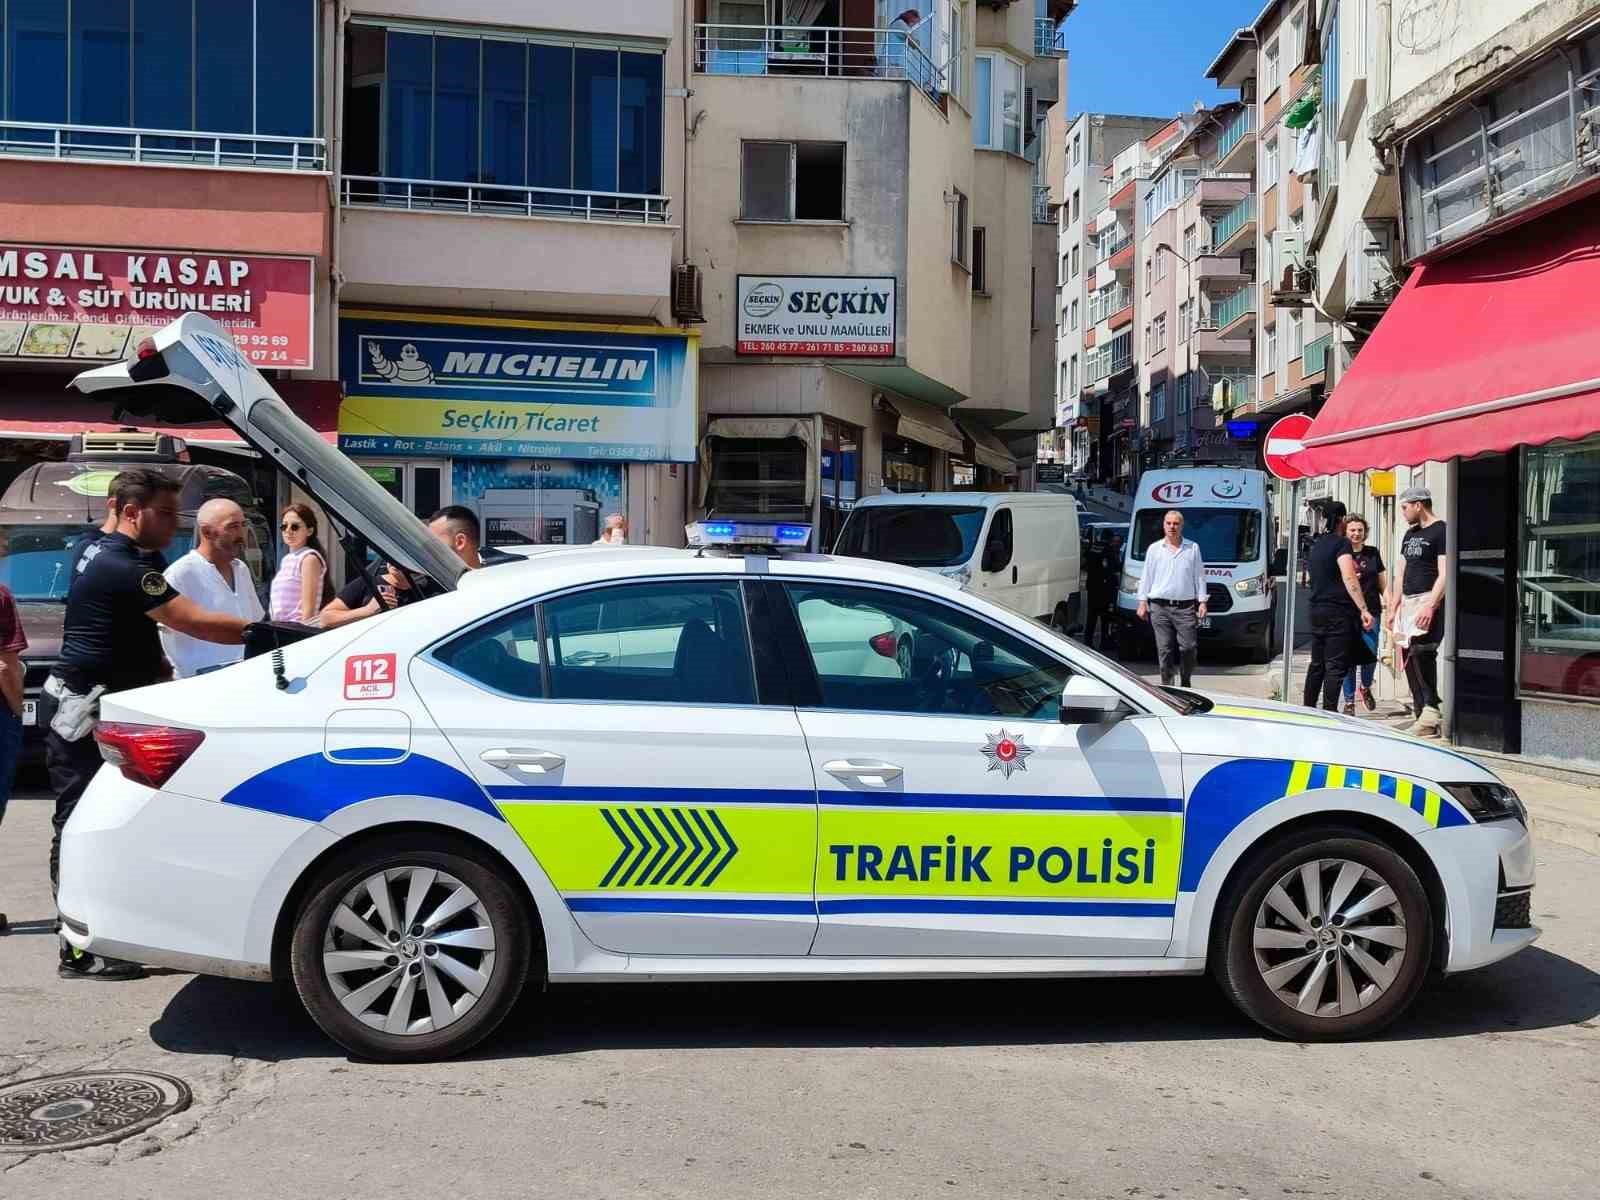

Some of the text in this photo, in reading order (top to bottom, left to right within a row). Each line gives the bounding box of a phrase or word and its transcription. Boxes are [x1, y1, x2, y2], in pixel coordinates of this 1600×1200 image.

[127, 256, 249, 287] KASAP
[47, 288, 65, 306] &
[78, 285, 123, 307] SÜT
[130, 286, 251, 312] ÜRÜNLERİ
[788, 286, 890, 320] SEÇKİN
[251, 335, 269, 345] 92
[745, 322, 891, 337] EKMEK ve UNLU MAMÜLLERİ
[743, 342, 759, 351] TEL:
[442, 351, 648, 381] MICHELIN
[441, 409, 600, 433] Seçkin Ticaret
[344, 438, 377, 449] Lastik
[394, 440, 415, 450] Rot
[1164, 485, 1194, 498] 112
[352, 658, 389, 681] 112
[829, 835, 1156, 885] TRAFİK POLİSİ
